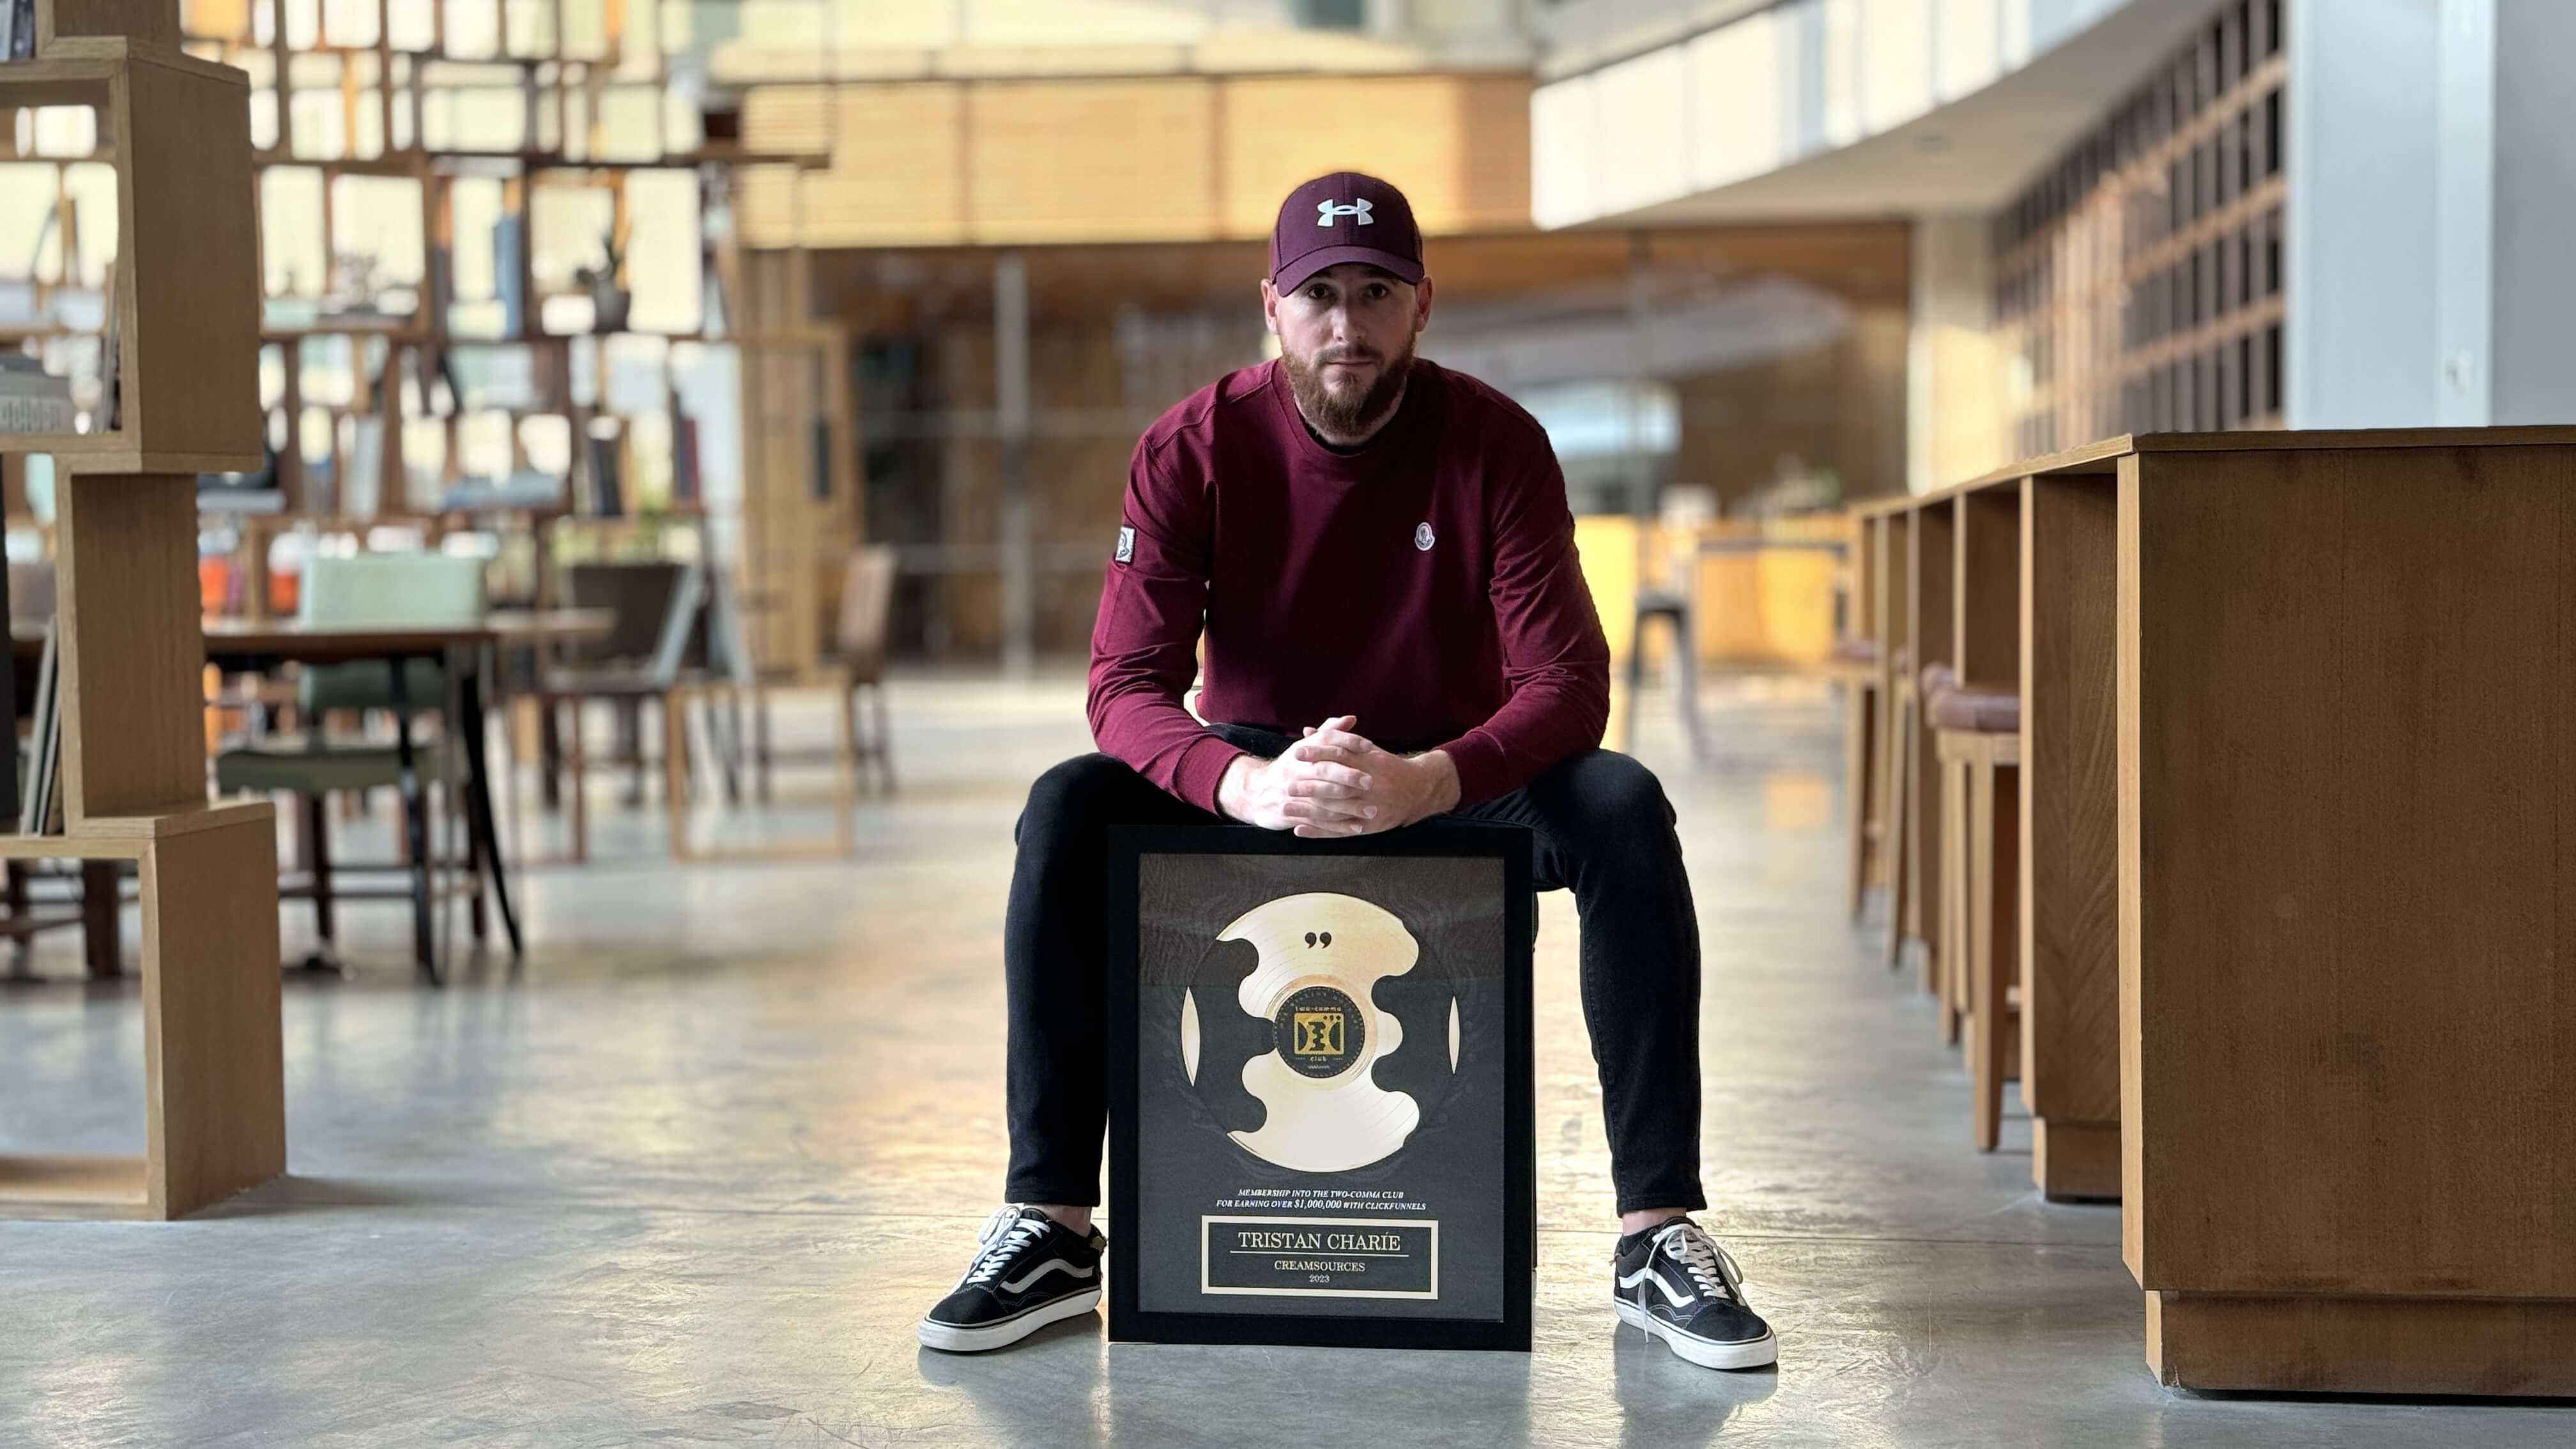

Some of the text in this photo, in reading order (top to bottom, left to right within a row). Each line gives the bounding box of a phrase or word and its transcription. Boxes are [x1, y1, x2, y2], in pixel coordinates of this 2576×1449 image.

[1238, 1188, 1291, 1197] MEMBERSHIP
[1312, 1190, 1328, 1198] THE
[1330, 1190, 1380, 1199] TWO-COMMA
[1216, 1199, 1233, 1208] FOR
[1234, 1200, 1269, 1208] EARNING
[1294, 1199, 1342, 1209] $1,000,000
[1365, 1202, 1427, 1211] CLICKFUNNELS
[1238, 1232, 1321, 1250] TRISTAN
[1274, 1261, 1365, 1273] CREAMSOURCES
[1309, 1275, 1330, 1284] 2023
